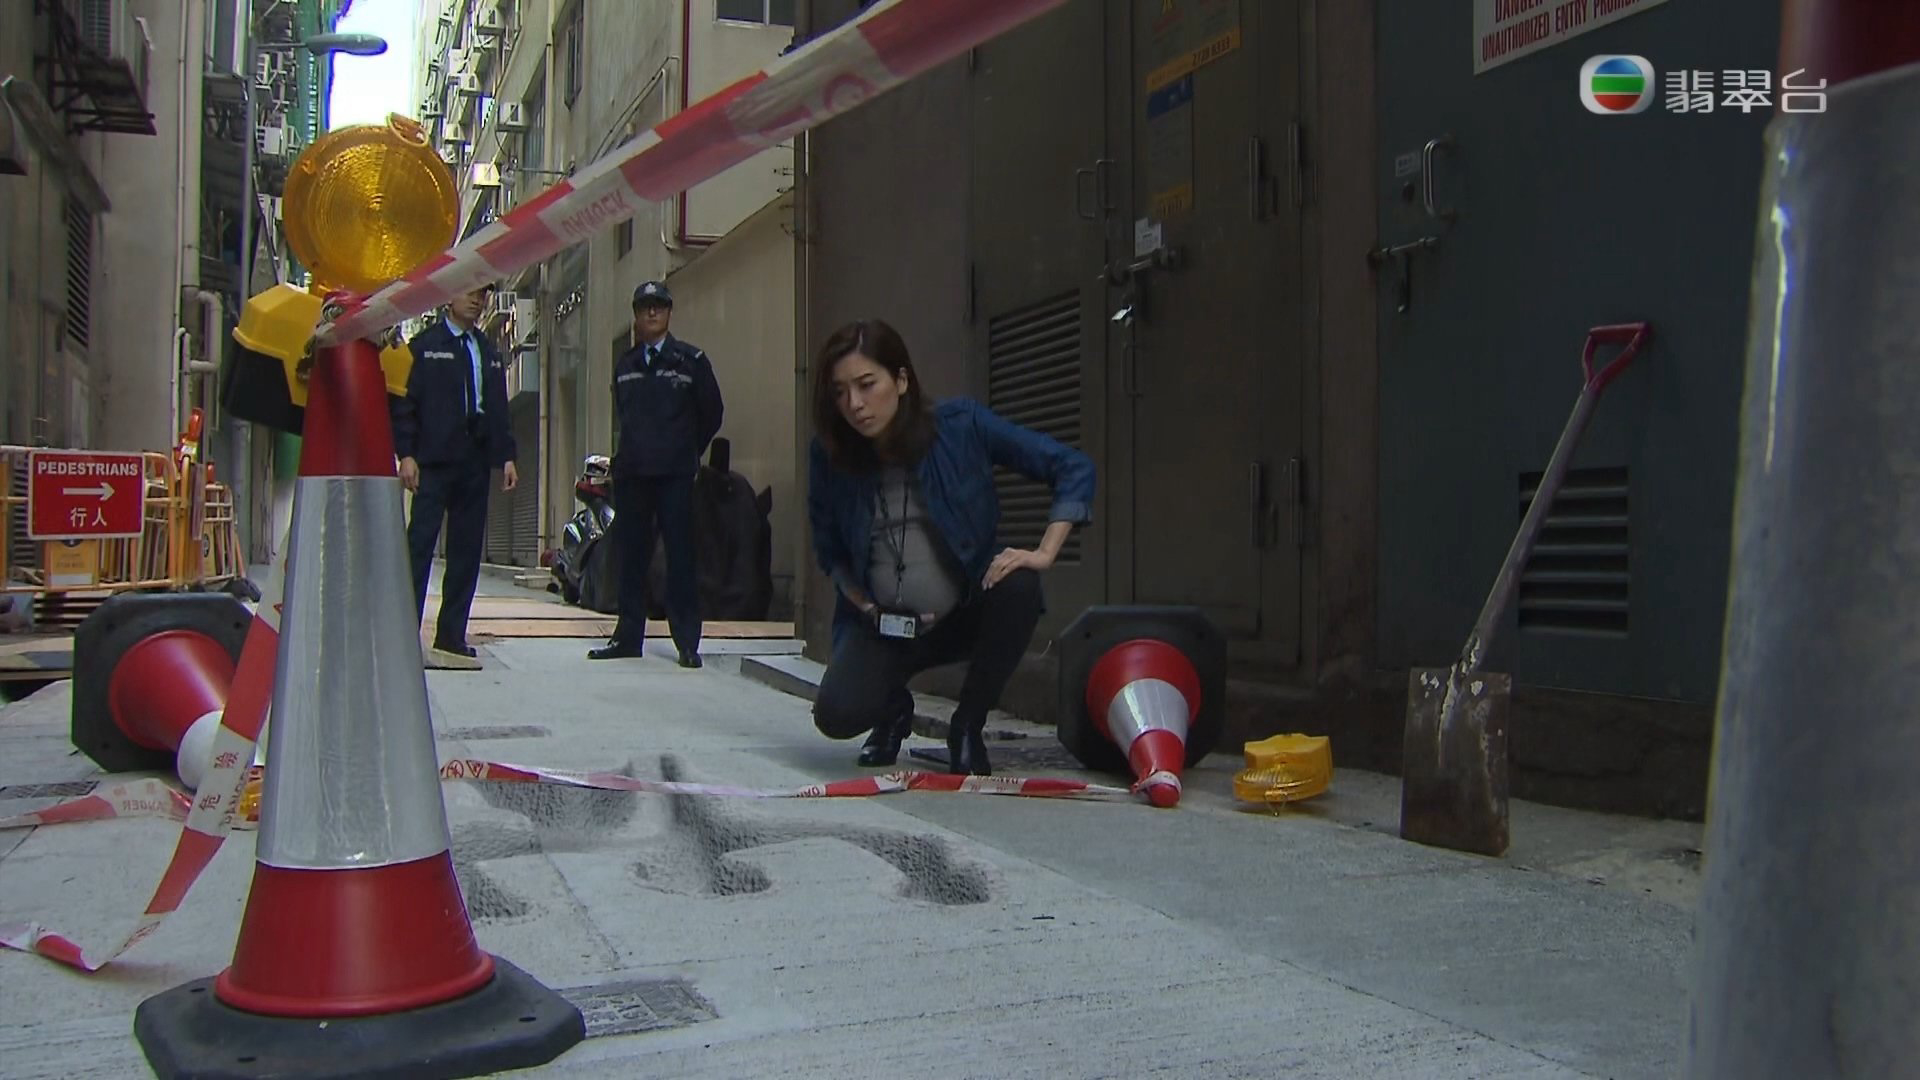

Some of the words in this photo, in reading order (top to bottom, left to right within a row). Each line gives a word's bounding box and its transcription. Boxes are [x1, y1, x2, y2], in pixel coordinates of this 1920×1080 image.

[1482, 12, 1550, 62] UNAUTHORIZED
[1555, 0, 1588, 33] ENTRY
[37, 461, 139, 476] PEDESTRIANS
[69, 506, 108, 527] 行人
